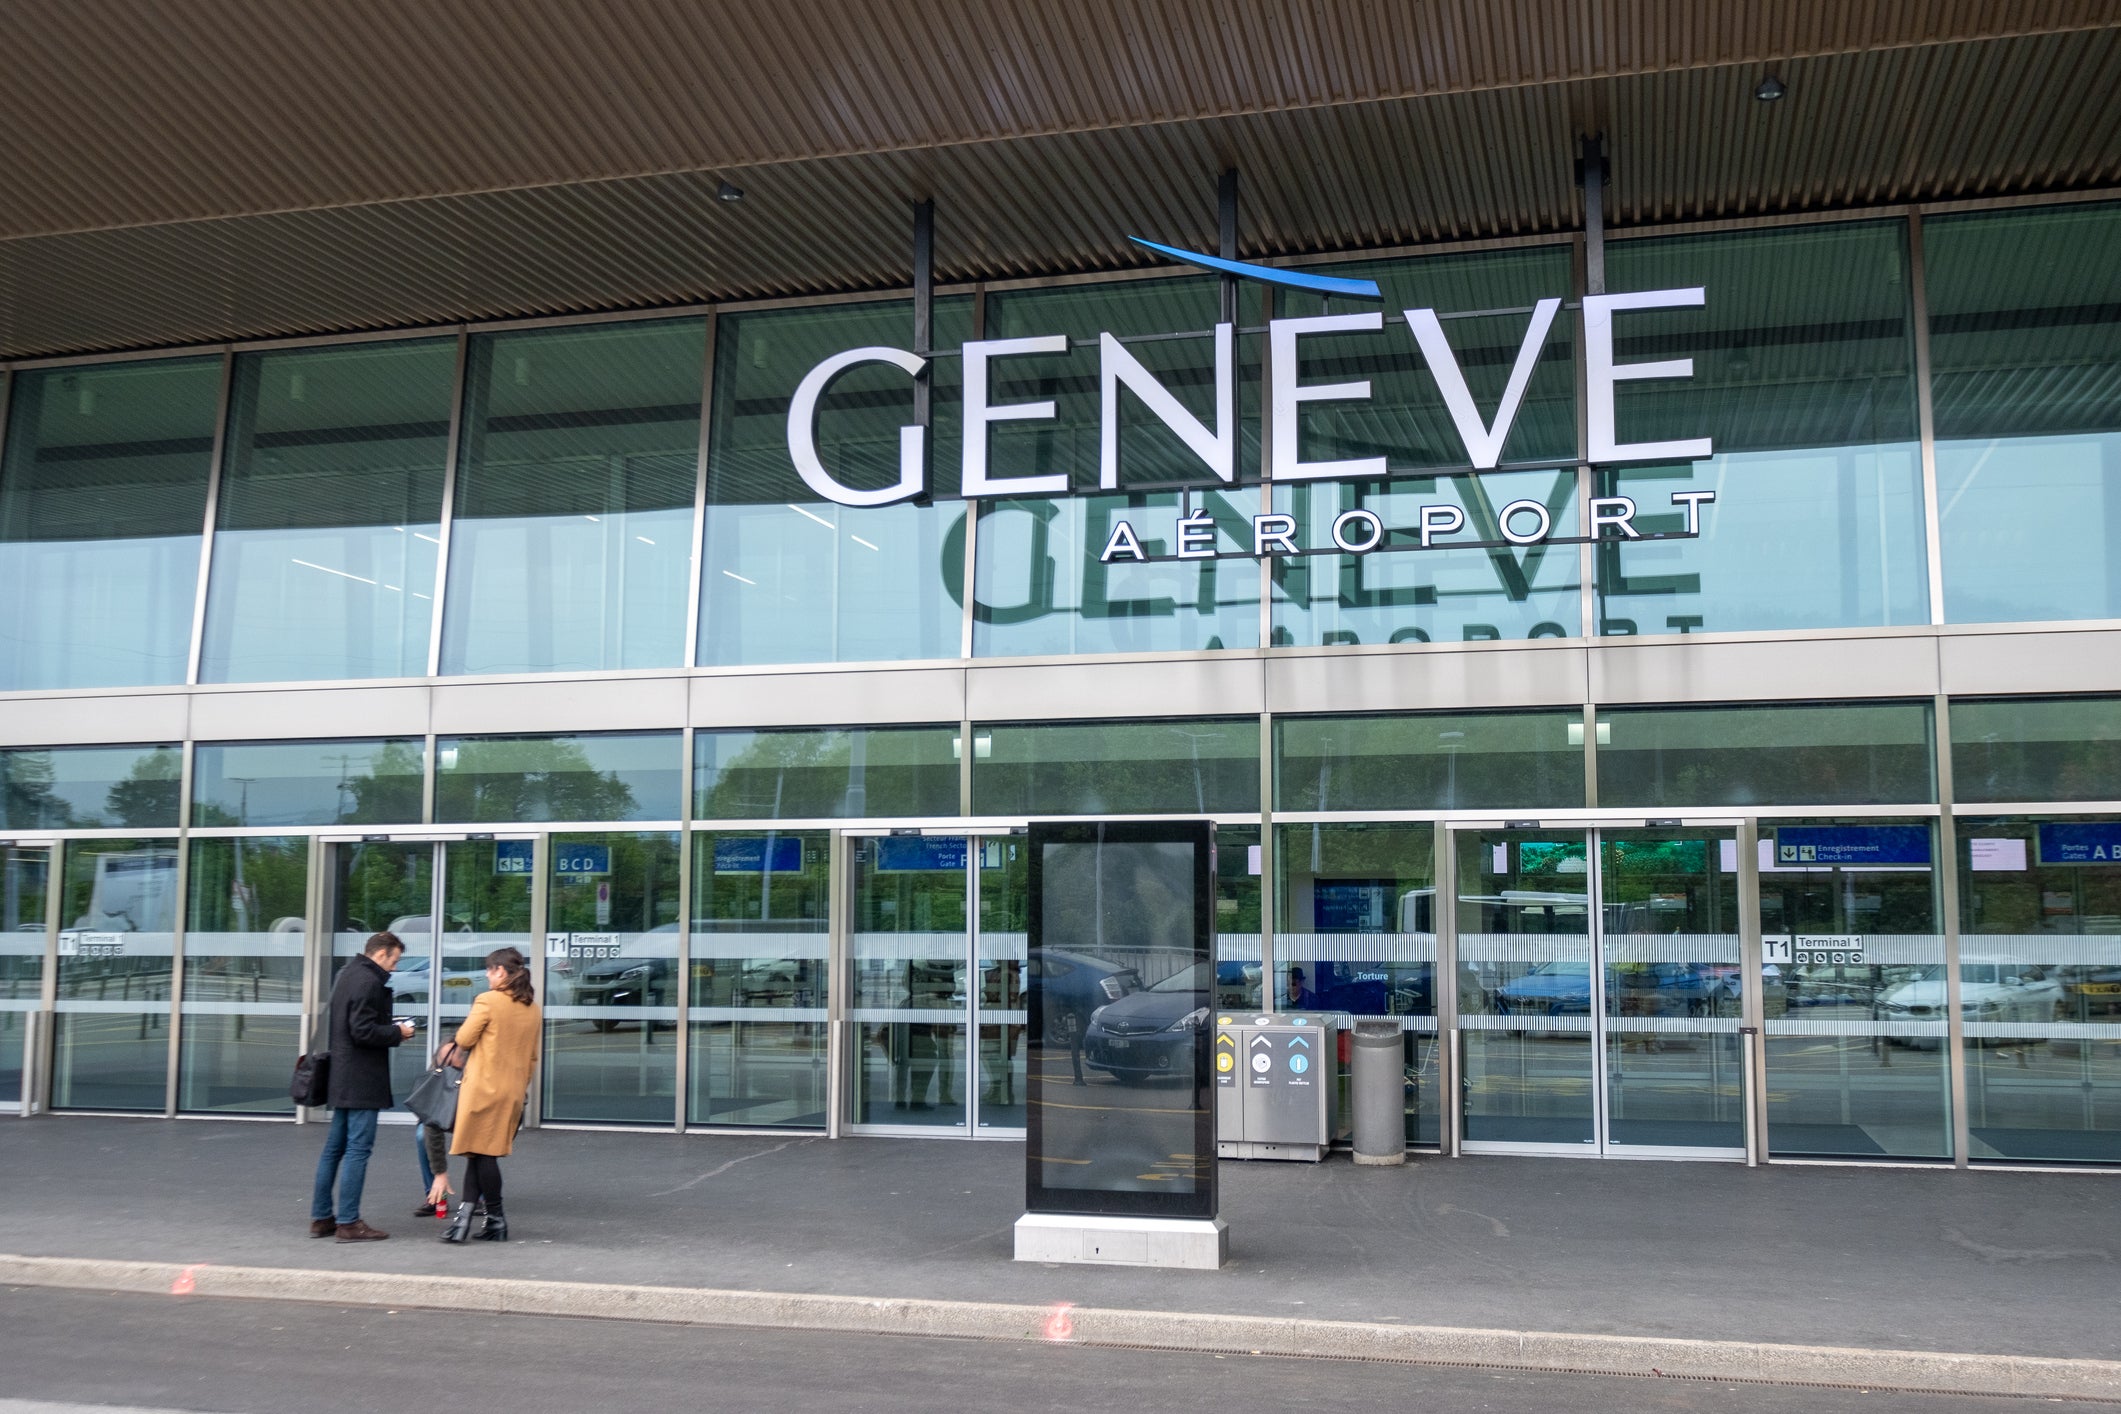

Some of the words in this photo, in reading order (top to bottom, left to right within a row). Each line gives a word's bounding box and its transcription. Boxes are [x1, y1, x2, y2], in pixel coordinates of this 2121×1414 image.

[1100, 491, 1717, 563] AÉROPORT
[1817, 845, 1880, 853] Enregistrement
[2093, 845, 2107, 859] A
[1817, 853, 1853, 861] Check-in
[573, 935, 612, 943] Terminal
[1798, 937, 1851, 947] Terminal
[548, 938, 566, 952] T1
[1764, 941, 1788, 957] T1
[1357, 971, 1389, 980] Torture
